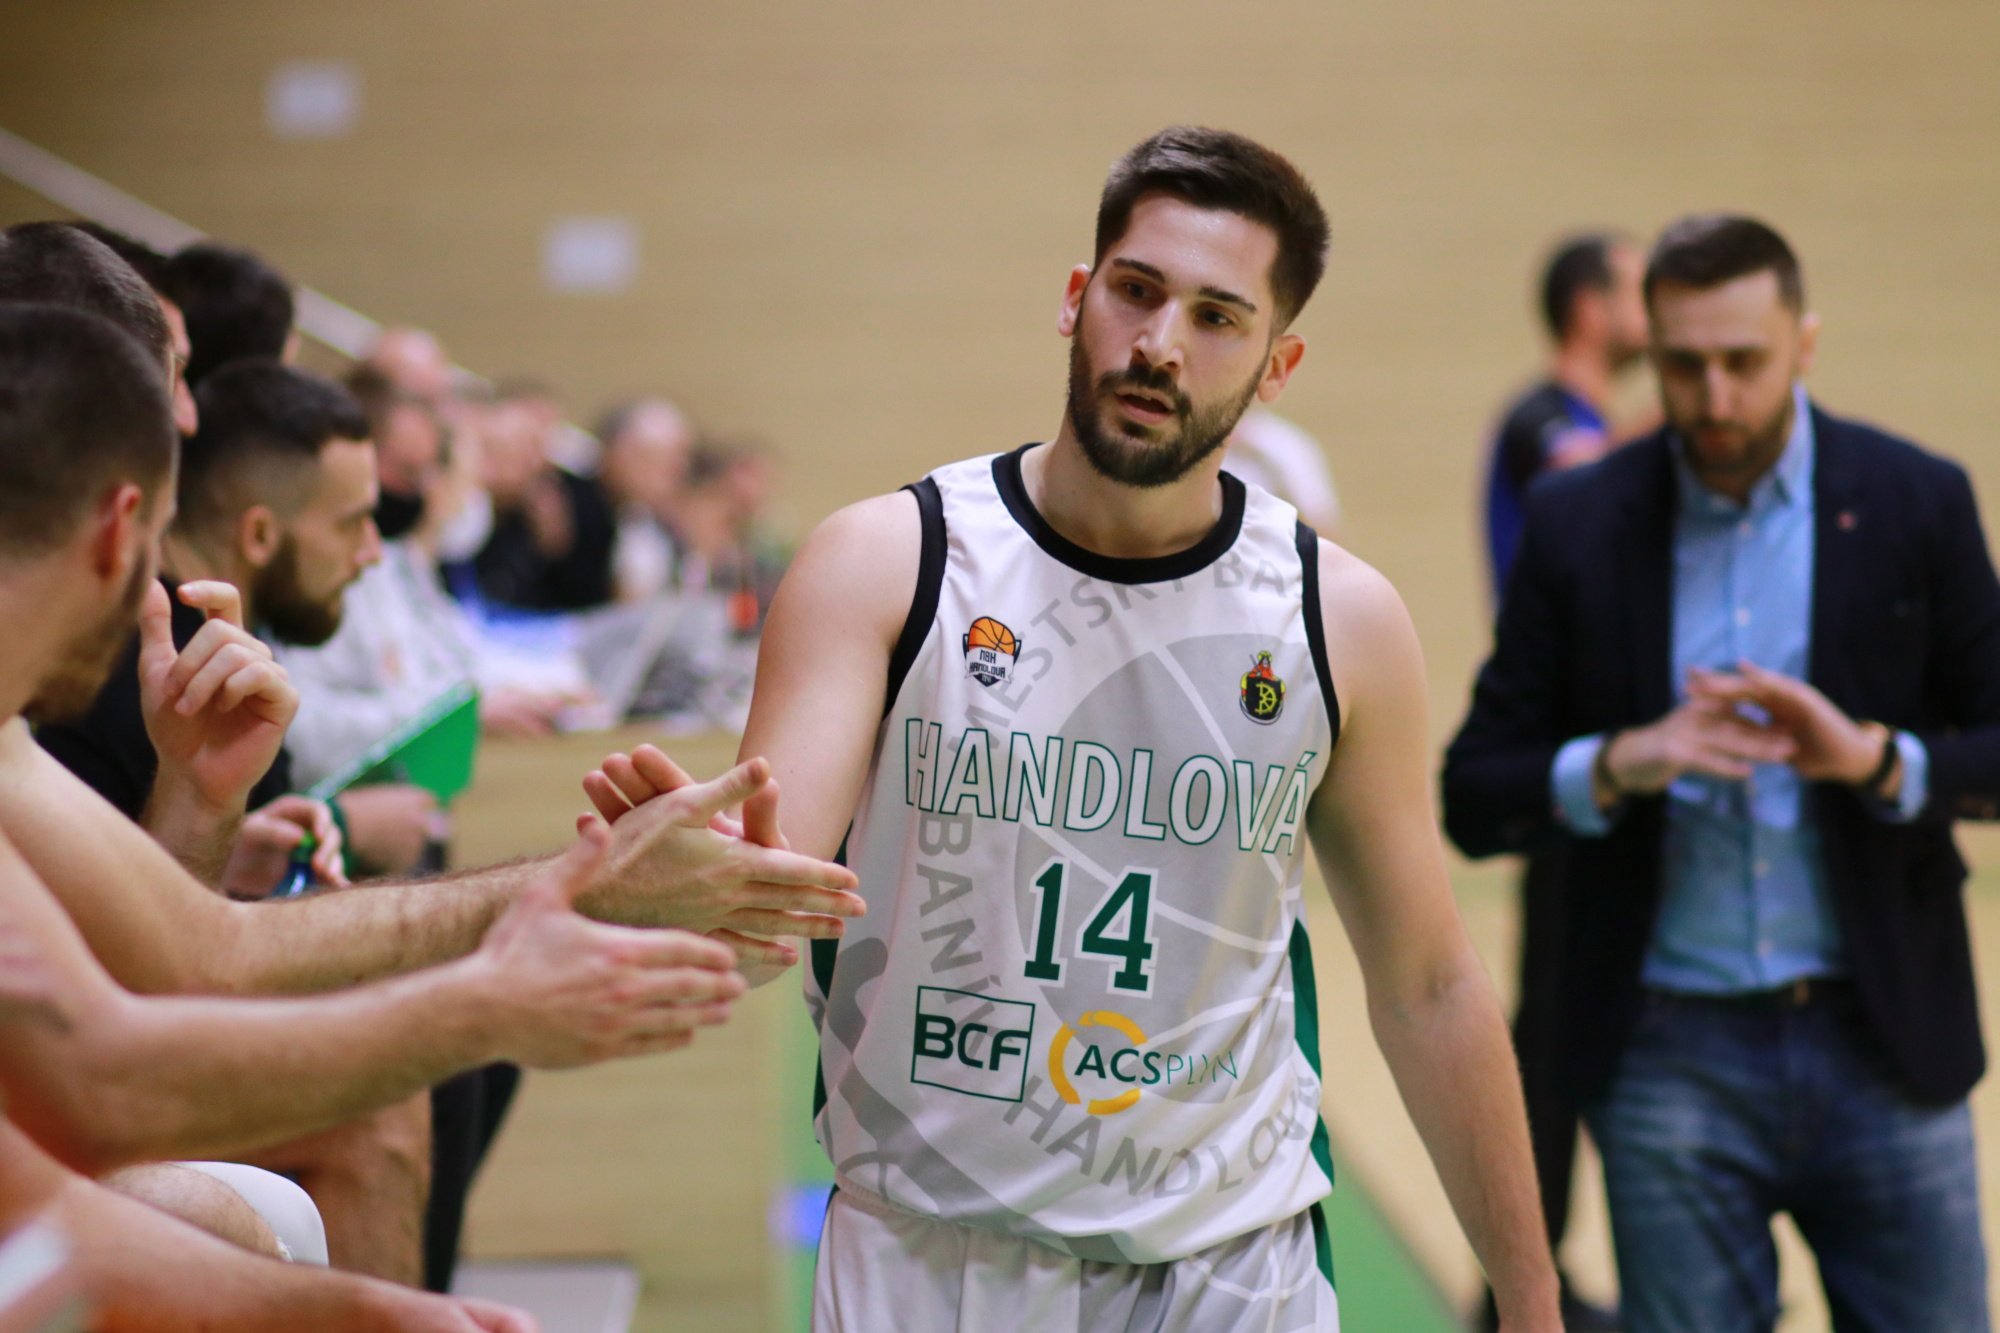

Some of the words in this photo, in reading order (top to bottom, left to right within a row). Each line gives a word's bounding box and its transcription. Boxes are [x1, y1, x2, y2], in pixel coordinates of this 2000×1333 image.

[906, 717, 1318, 856] HANDLOVÁ
[1023, 861, 1155, 993] 14
[913, 1013, 1031, 1072] BCF
